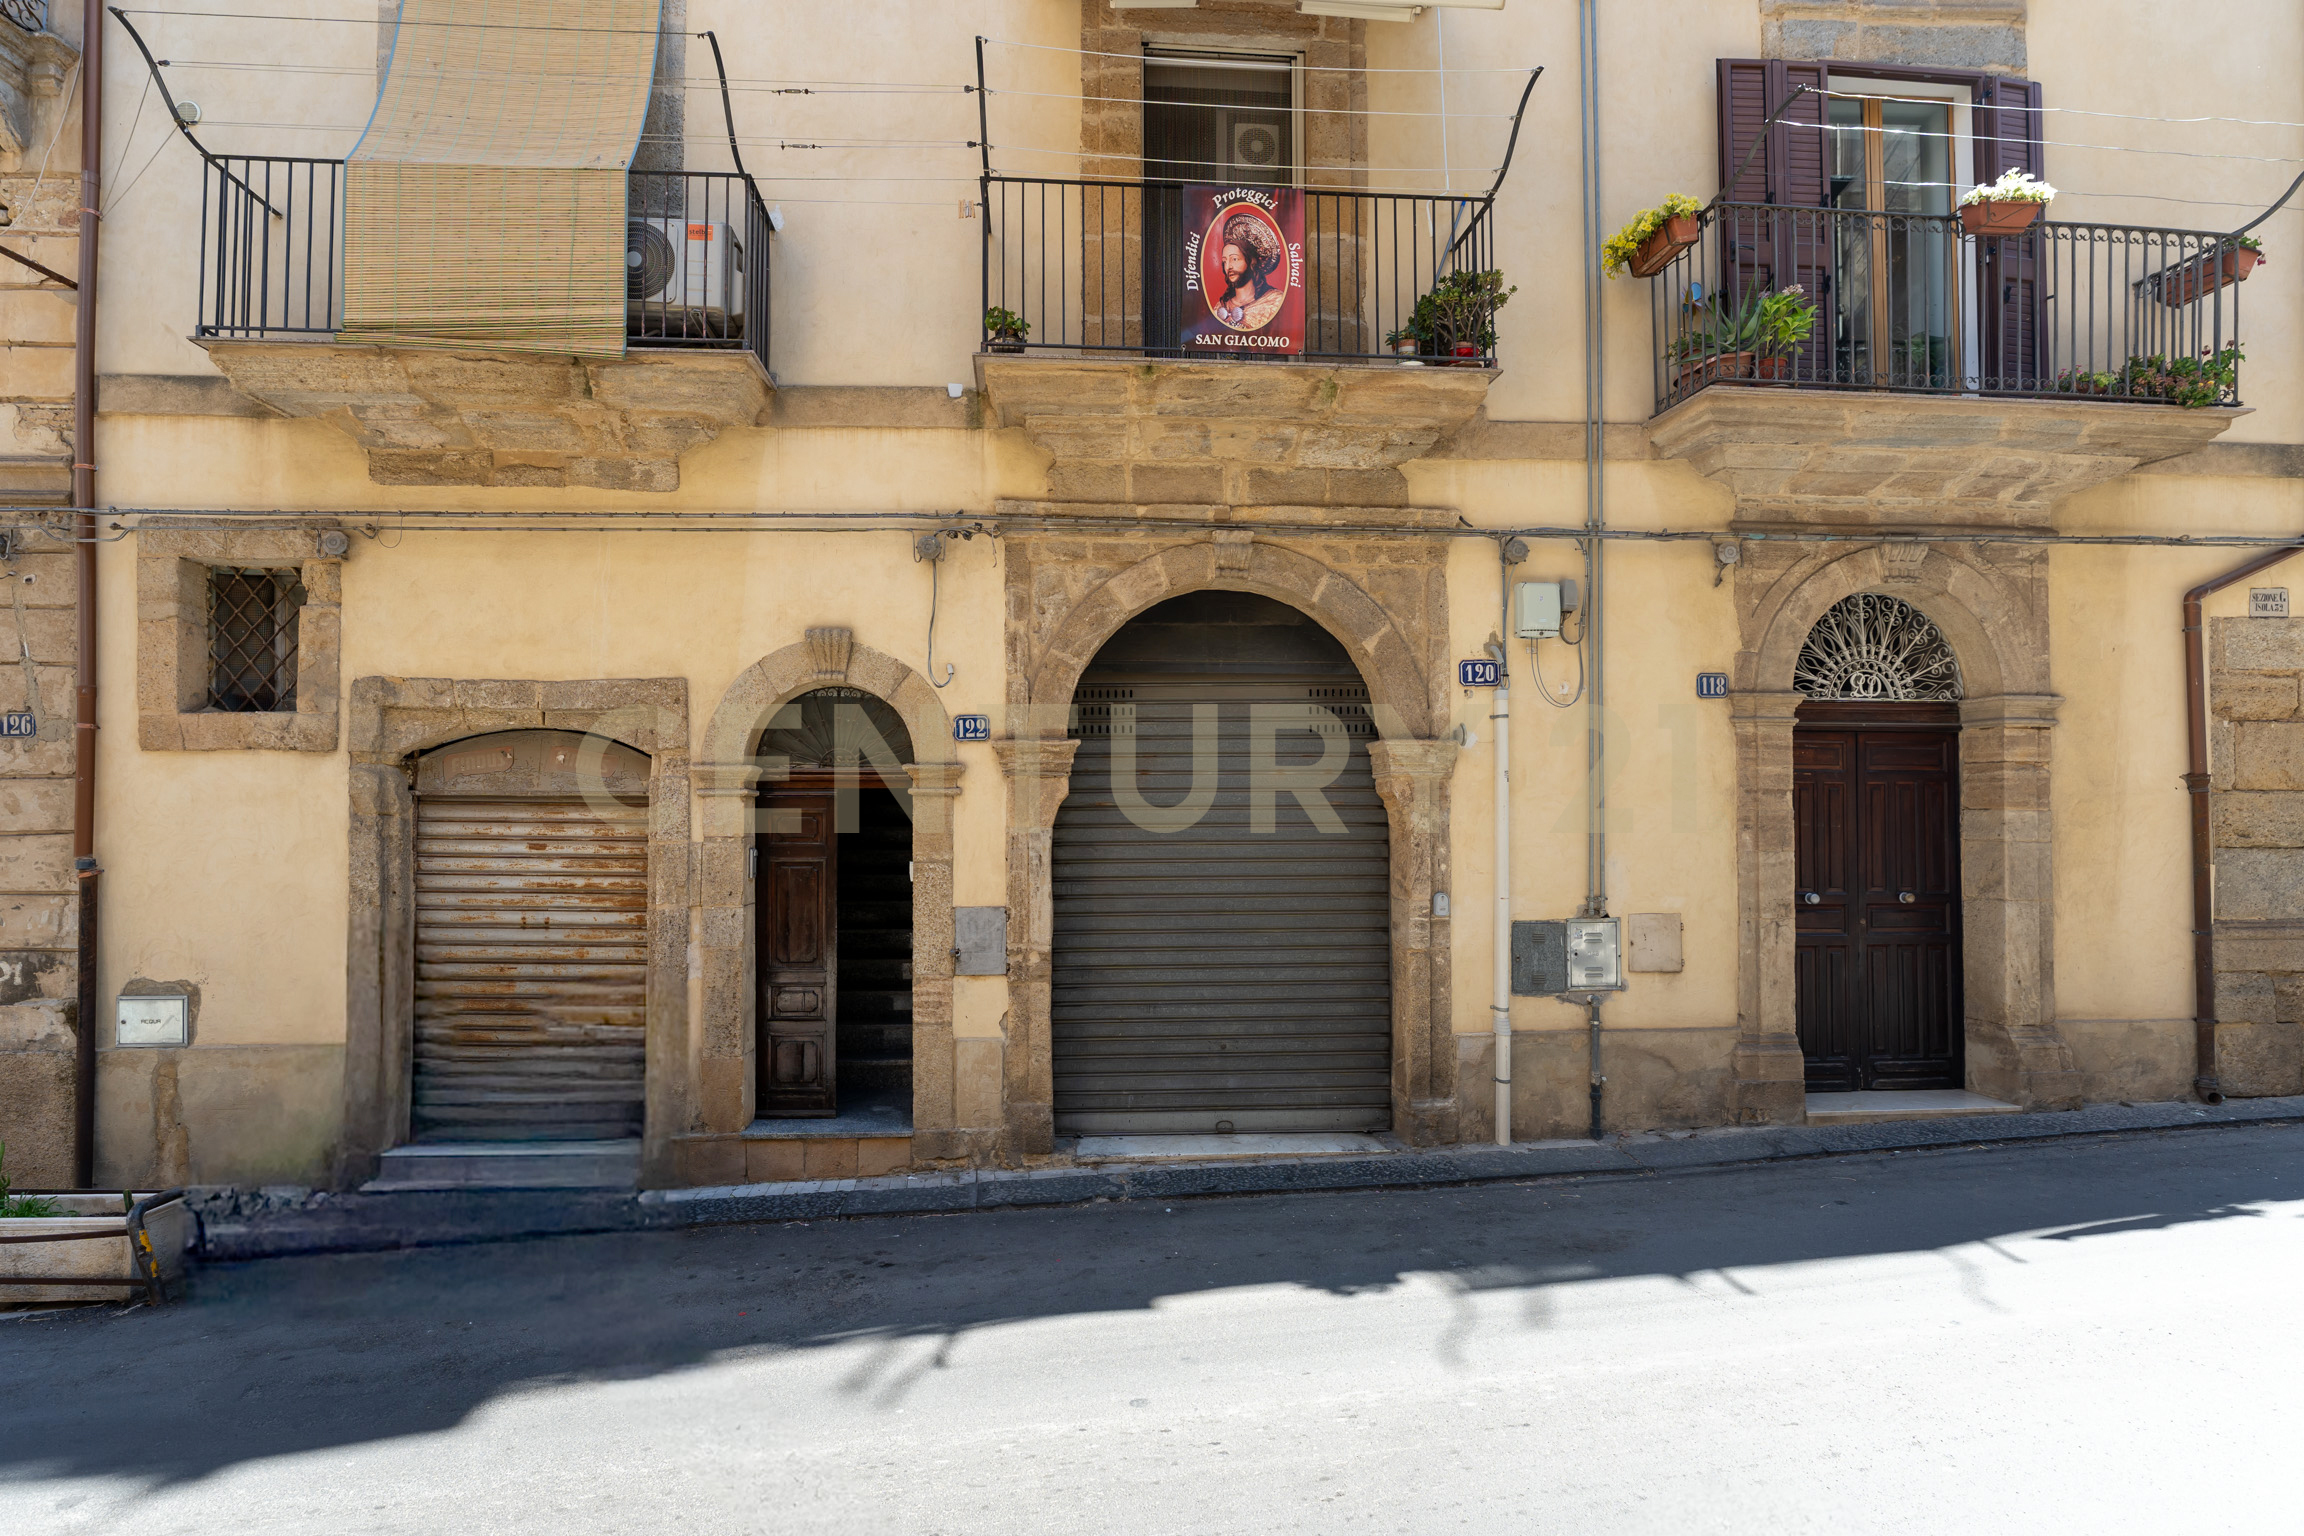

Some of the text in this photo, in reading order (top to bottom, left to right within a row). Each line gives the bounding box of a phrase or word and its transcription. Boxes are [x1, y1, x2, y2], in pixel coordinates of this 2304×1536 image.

[1212, 187, 1279, 210] Proteggici
[1183, 231, 1201, 291] Difendici
[1288, 242, 1304, 288] Salvaci
[1195, 333, 1290, 348] SAN GIACOMO
[2251, 592, 2279, 603] SEZIONE
[2255, 602, 2274, 612] ISOLA
[1465, 663, 1495, 682] 120
[1702, 676, 1725, 695] 118
[2, 715, 31, 735] 126
[958, 718, 986, 738] 122
[140, 1018, 162, 1026] ACQUA
